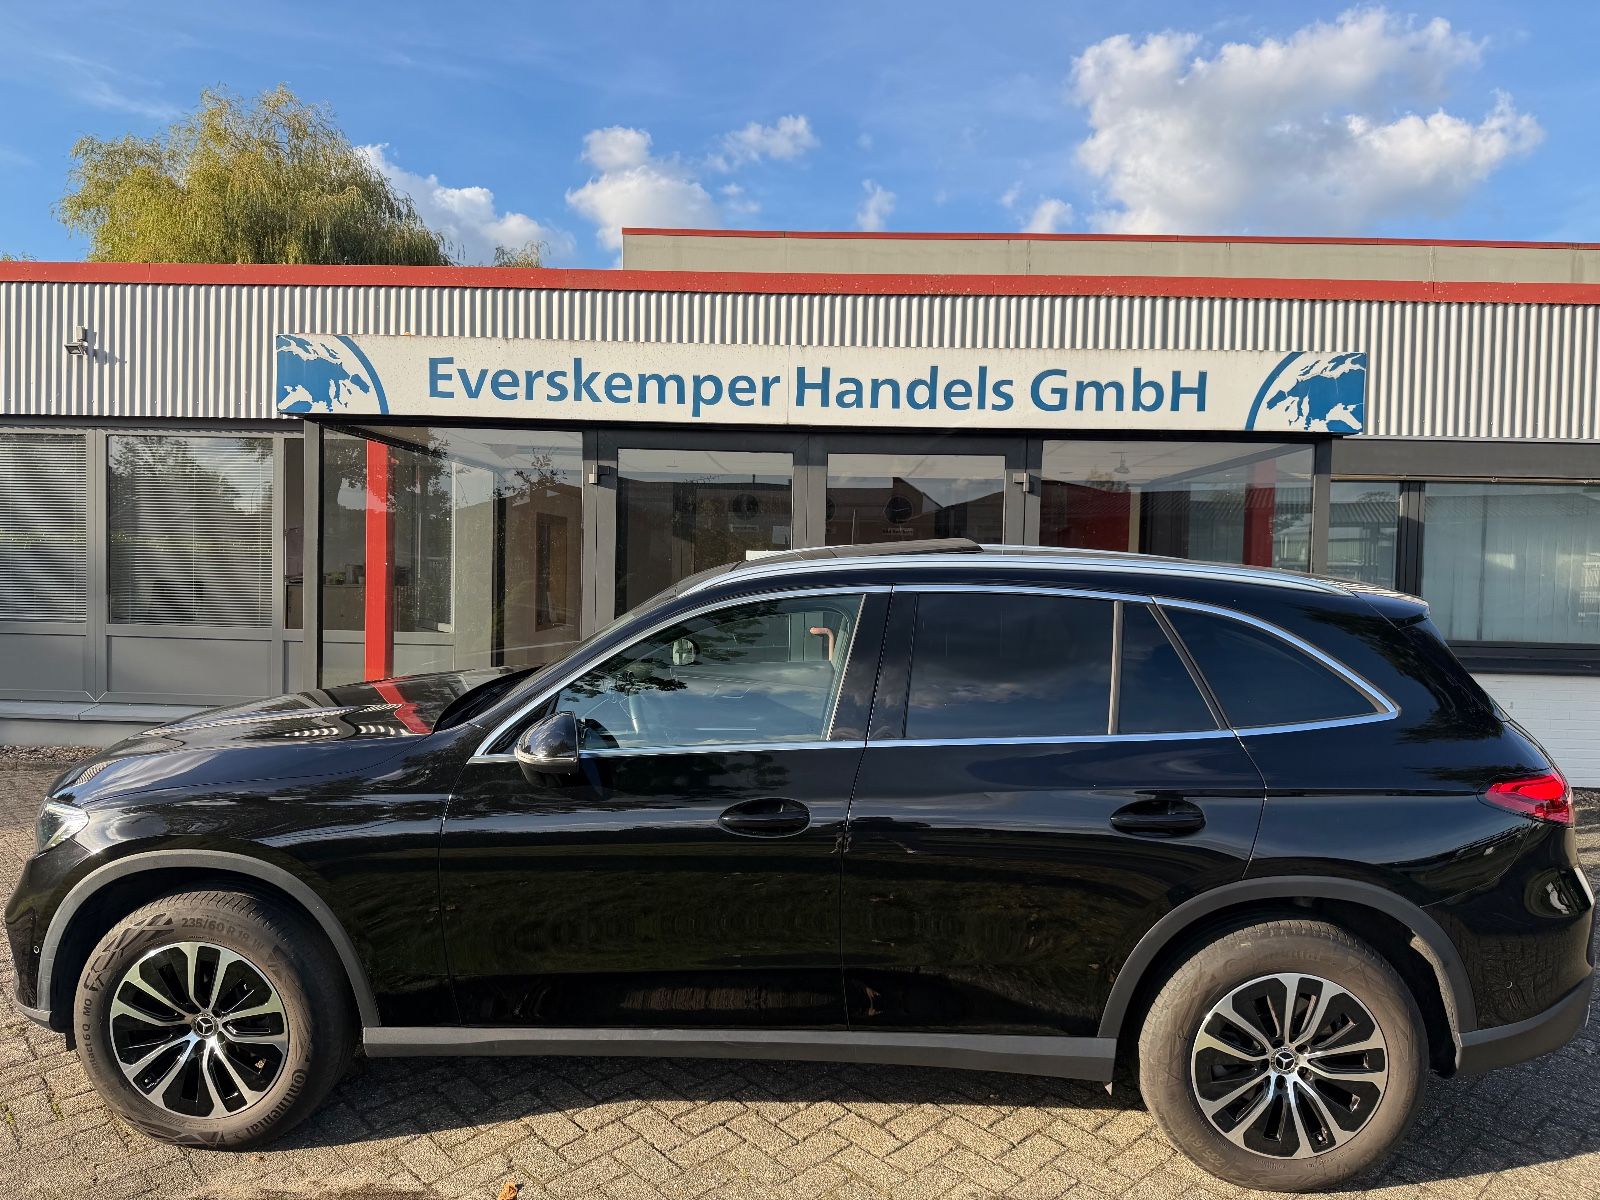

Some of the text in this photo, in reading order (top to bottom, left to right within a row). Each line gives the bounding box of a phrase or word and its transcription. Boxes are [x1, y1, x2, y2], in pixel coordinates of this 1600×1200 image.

[429, 356, 1207, 417] Everskemper Handels GmbH
[181, 917, 225, 932] 235/60
[226, 925, 236, 936] R
[82, 998, 92, 1017] MO
[245, 1068, 307, 1137] Continental
